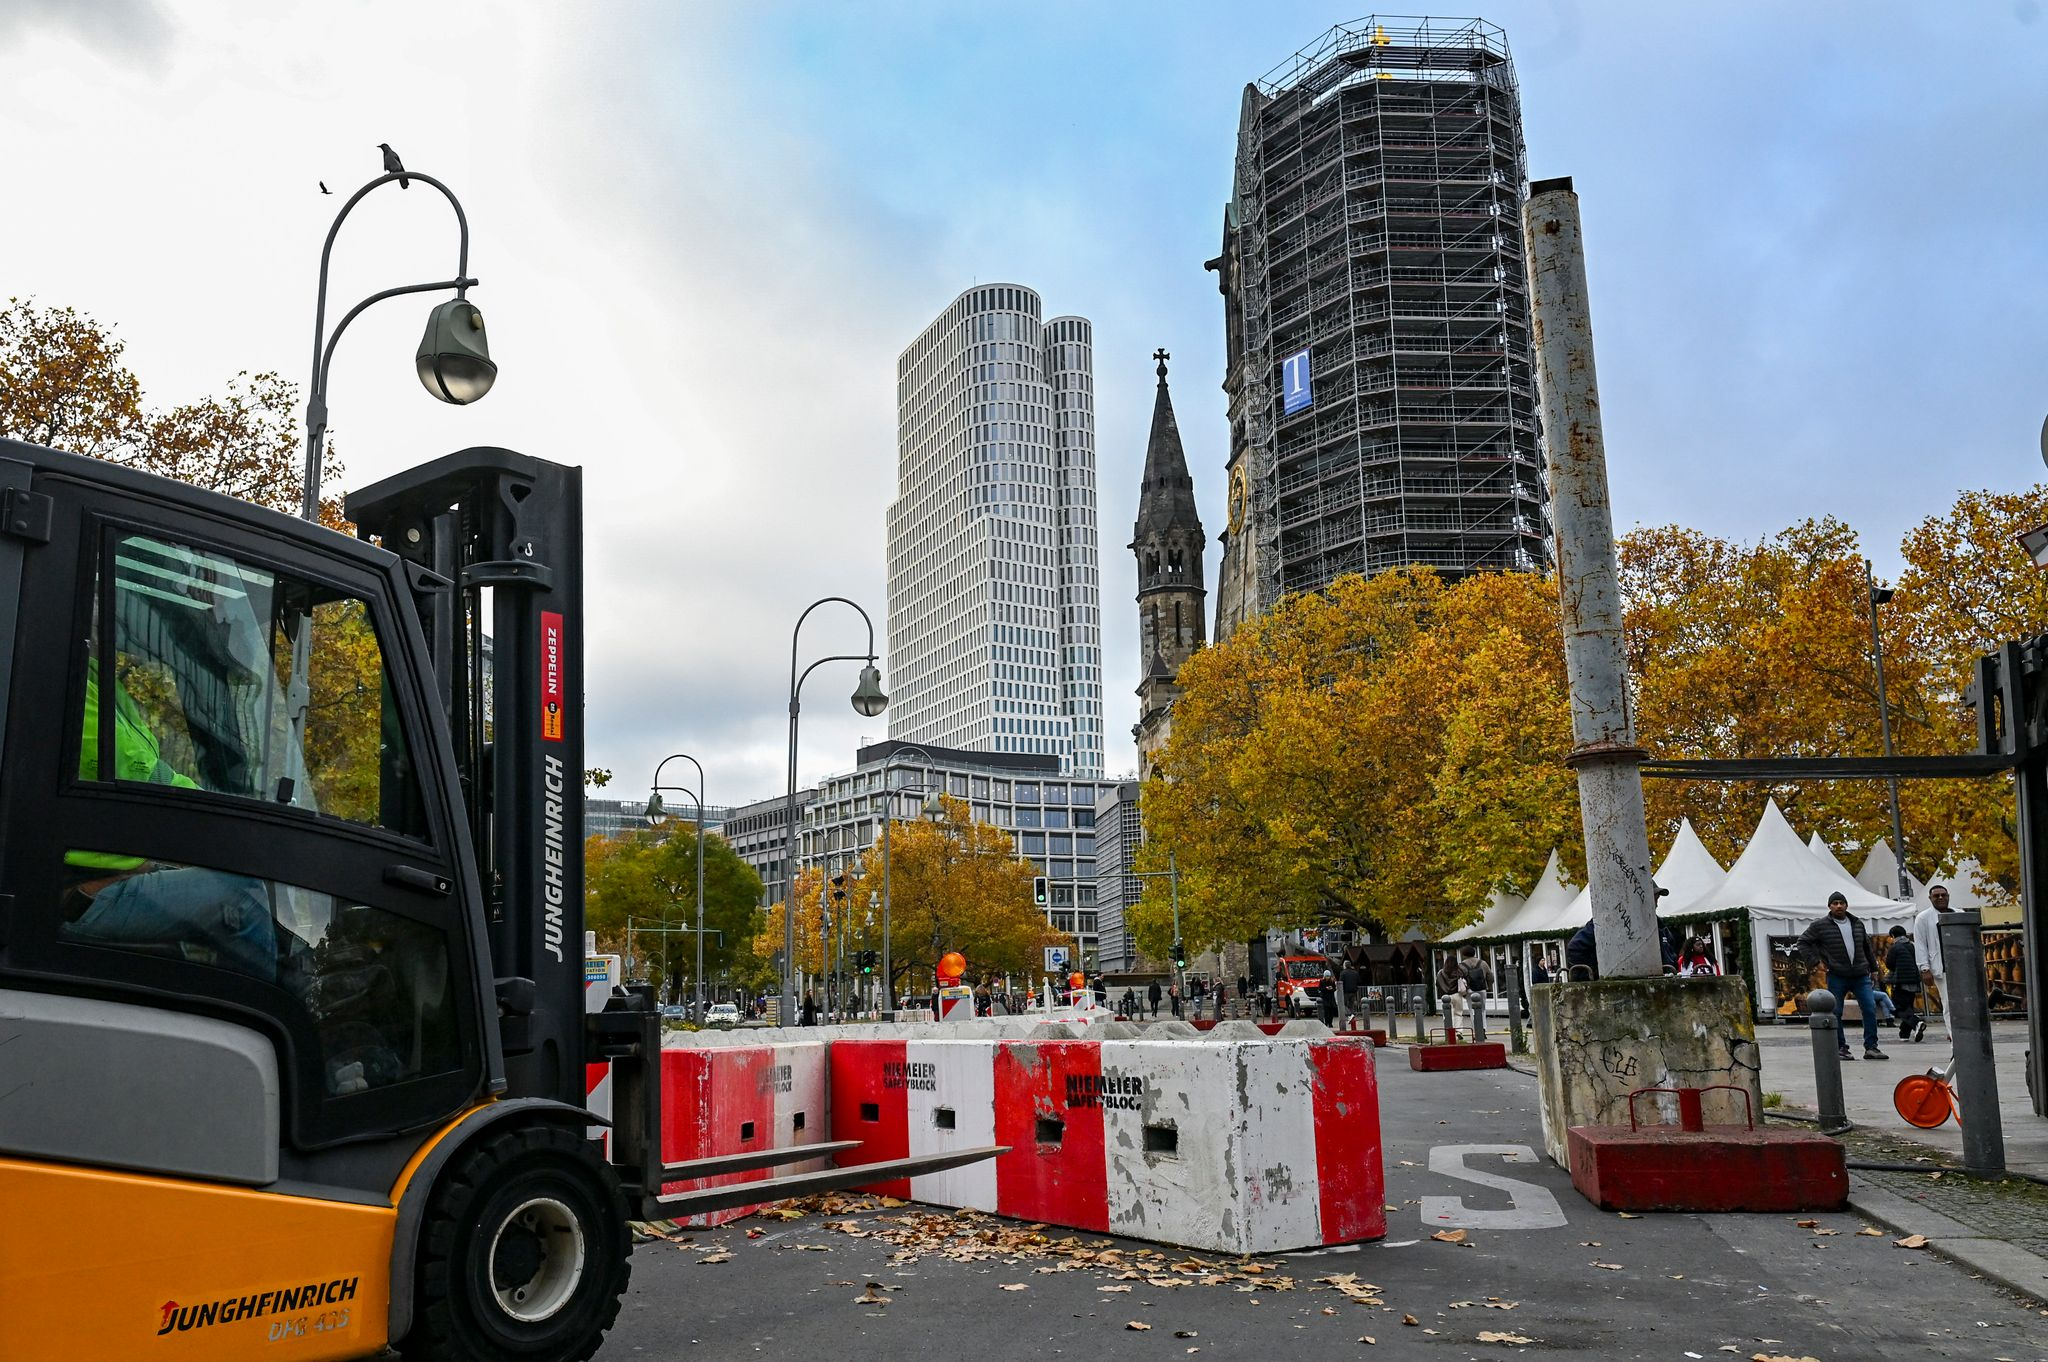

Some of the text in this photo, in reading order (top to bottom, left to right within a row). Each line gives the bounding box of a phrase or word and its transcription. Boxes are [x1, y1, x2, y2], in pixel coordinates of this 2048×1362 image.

[1285, 351, 1308, 394] T
[548, 627, 557, 694] ZEPPELIN
[545, 754, 563, 963] JUNGHEINRICH
[884, 1062, 936, 1078] NIEMEIER
[1066, 1074, 1143, 1095] NIEMEIER
[1421, 1144, 1569, 1229] S
[157, 1277, 359, 1336] JUNGHEINRICH
